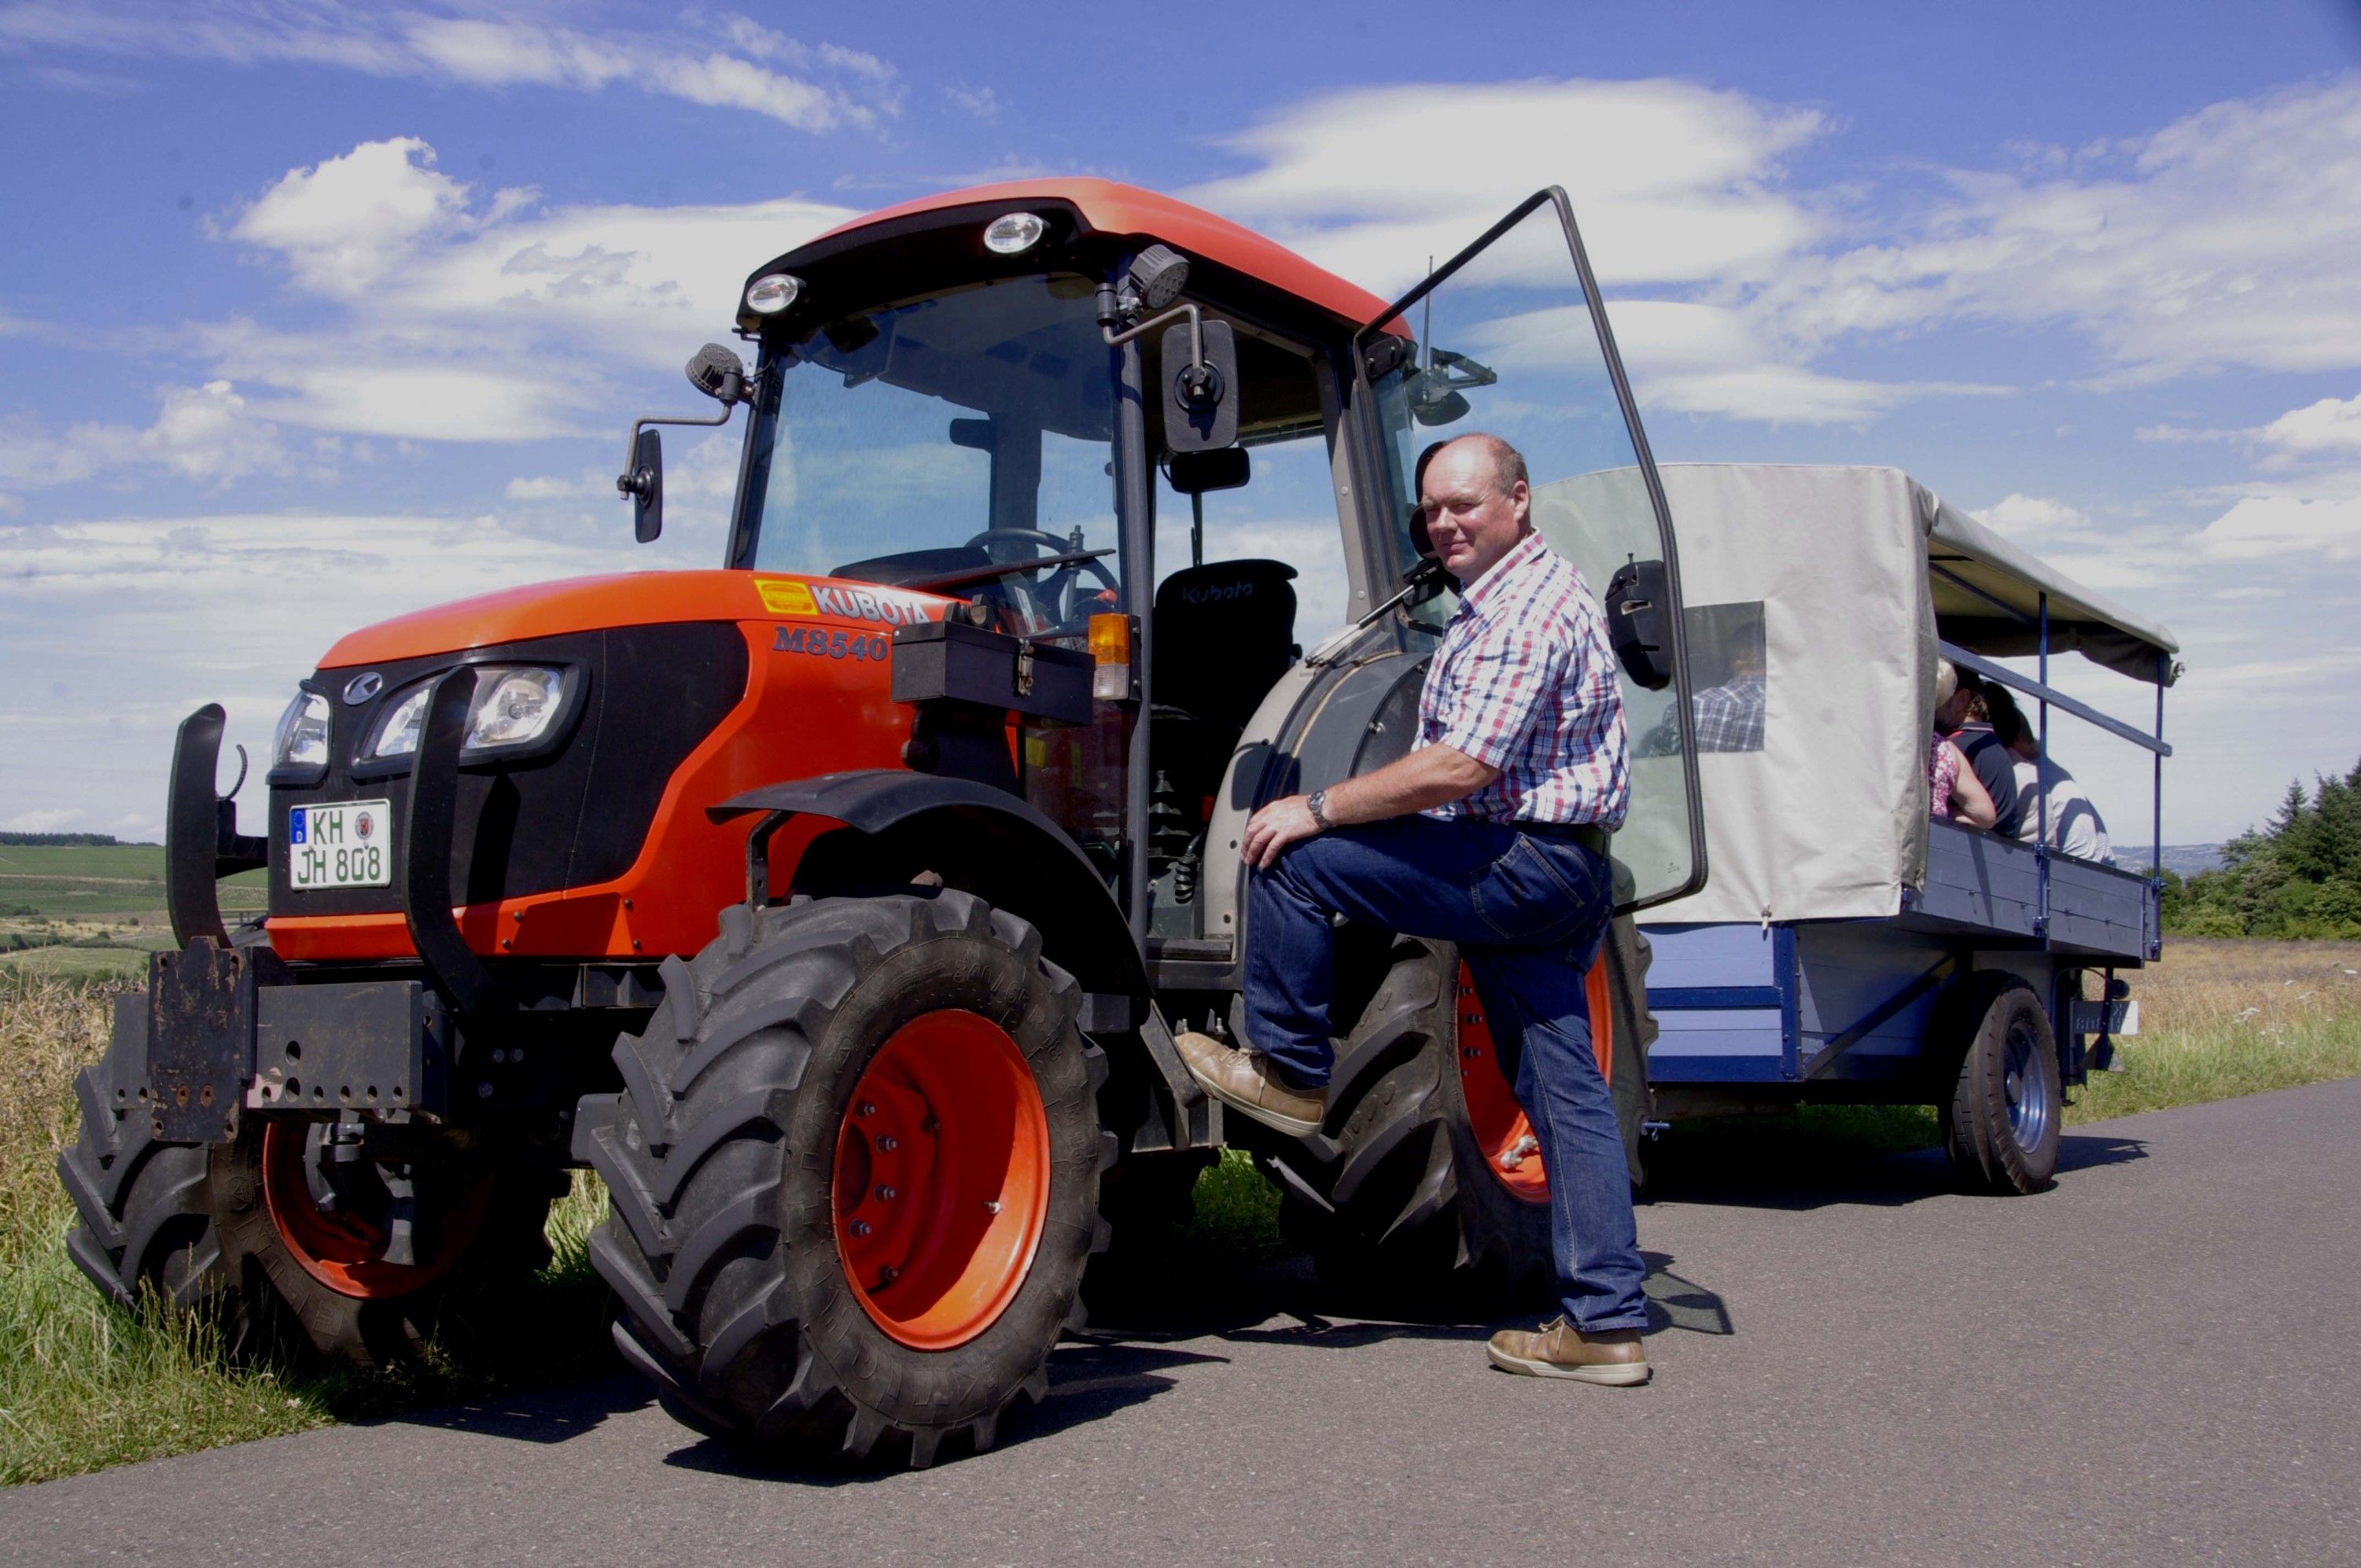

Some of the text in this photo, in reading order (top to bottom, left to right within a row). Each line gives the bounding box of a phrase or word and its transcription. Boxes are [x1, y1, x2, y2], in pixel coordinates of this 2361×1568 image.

[810, 584, 932, 625] KUBOTA
[1181, 580, 1254, 604] Kubota
[772, 626, 888, 661] M8540
[296, 810, 344, 845] D KH
[297, 846, 381, 885] JH 808
